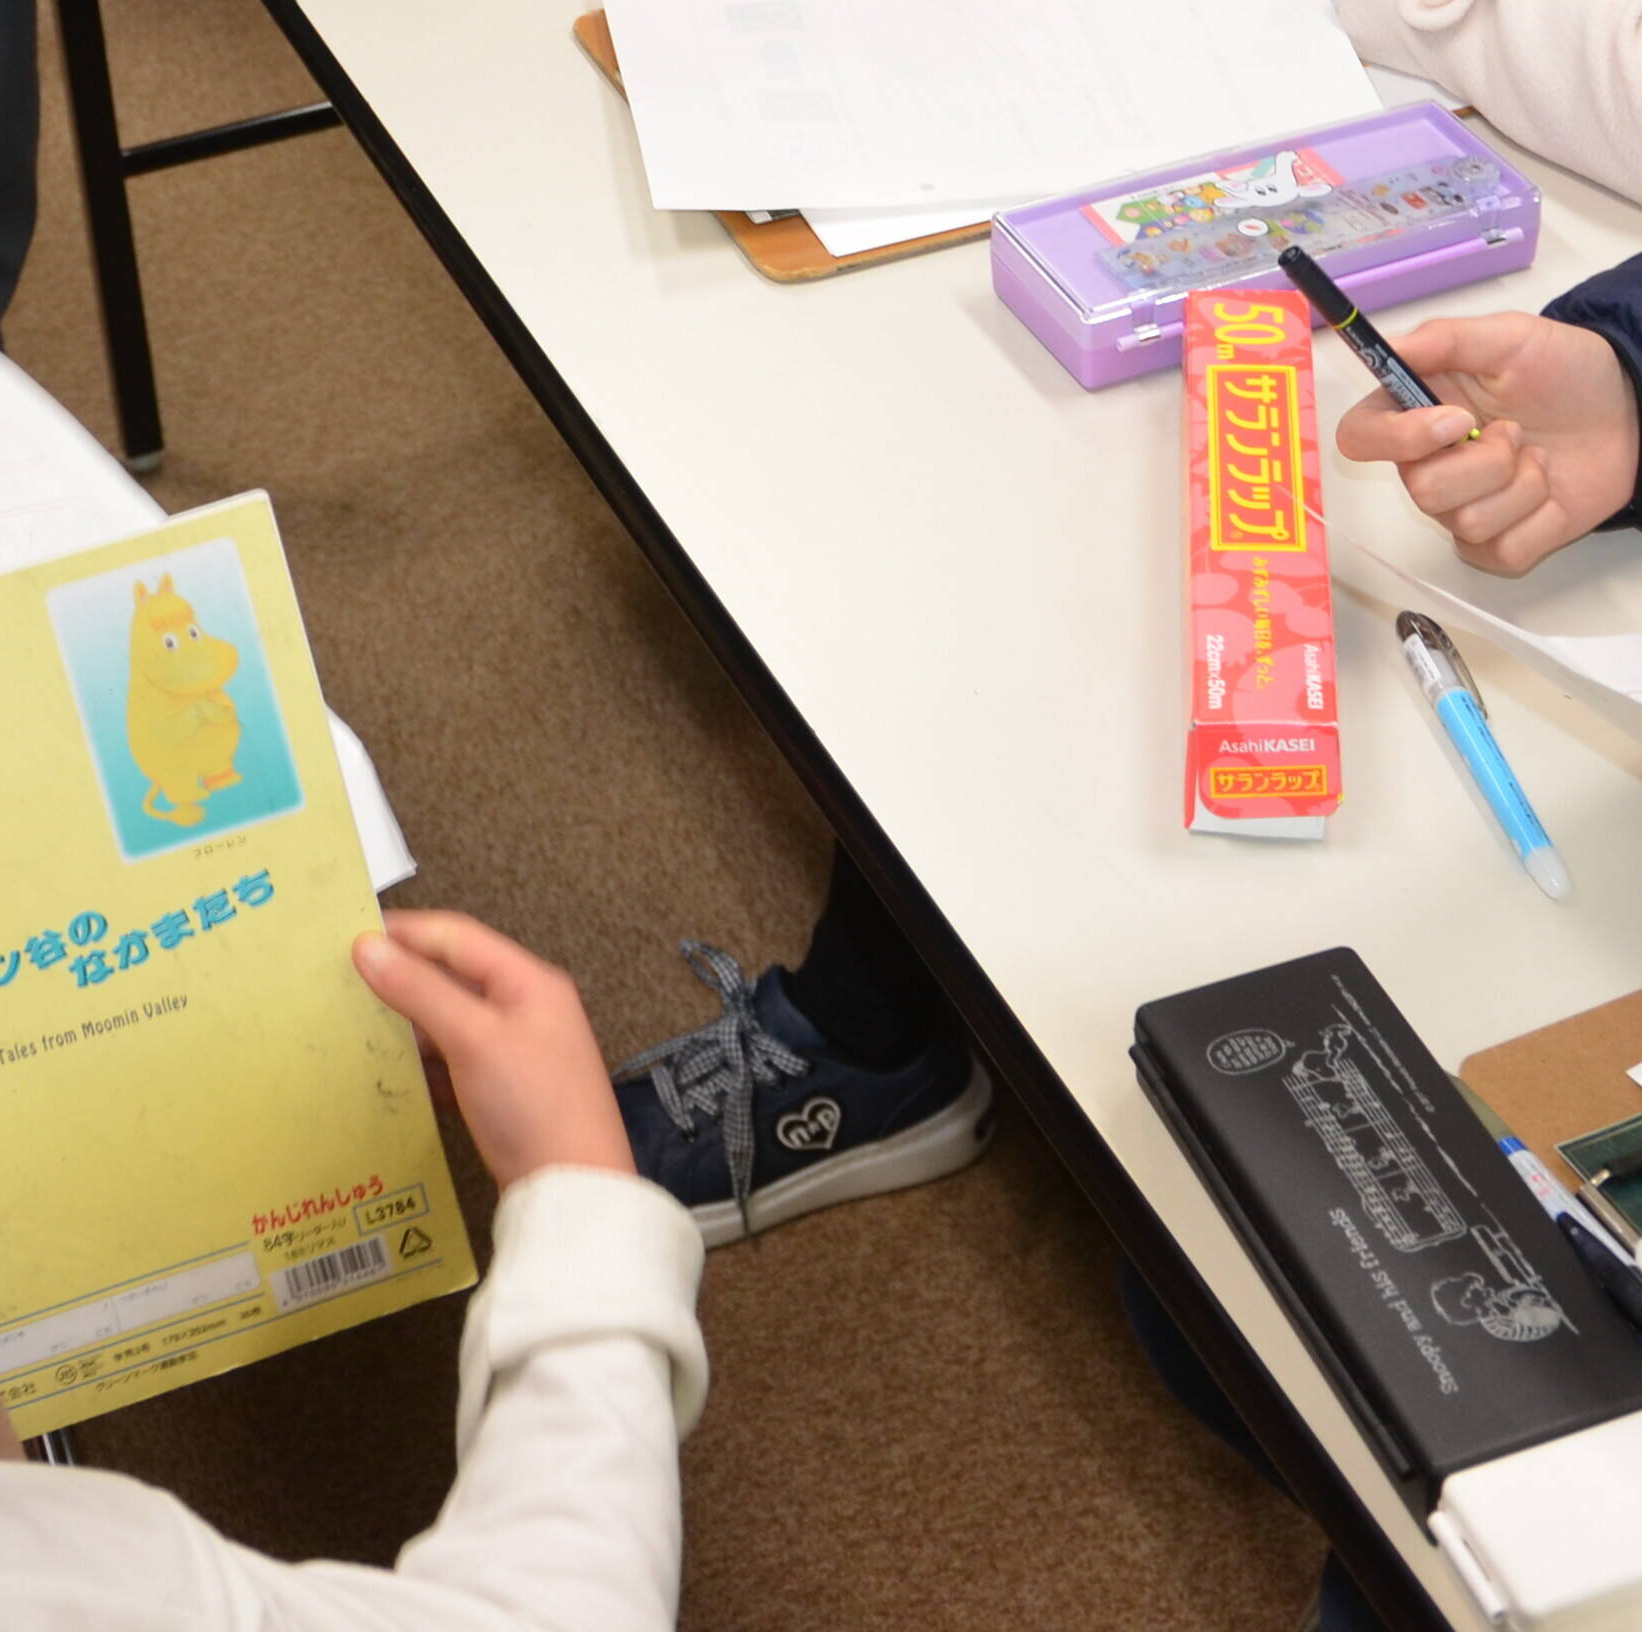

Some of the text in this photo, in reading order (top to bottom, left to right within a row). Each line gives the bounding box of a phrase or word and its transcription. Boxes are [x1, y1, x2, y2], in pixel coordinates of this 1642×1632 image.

[1224, 374, 1291, 540] サランラップ
[1304, 644, 1324, 710] AsahiKASEI
[1219, 738, 1315, 753] AsahiKASEI
[1217, 772, 1321, 792] サランラップ
[68, 868, 275, 987] なかまたち
[42, 1025, 77, 1052] from
[81, 1009, 138, 1039] Moomin
[144, 994, 187, 1019] Valley
[252, 1175, 383, 1235] かんじれんしゅう
[366, 1197, 415, 1225] L3784
[1324, 1203, 1464, 1398] Snoopy and his friends
